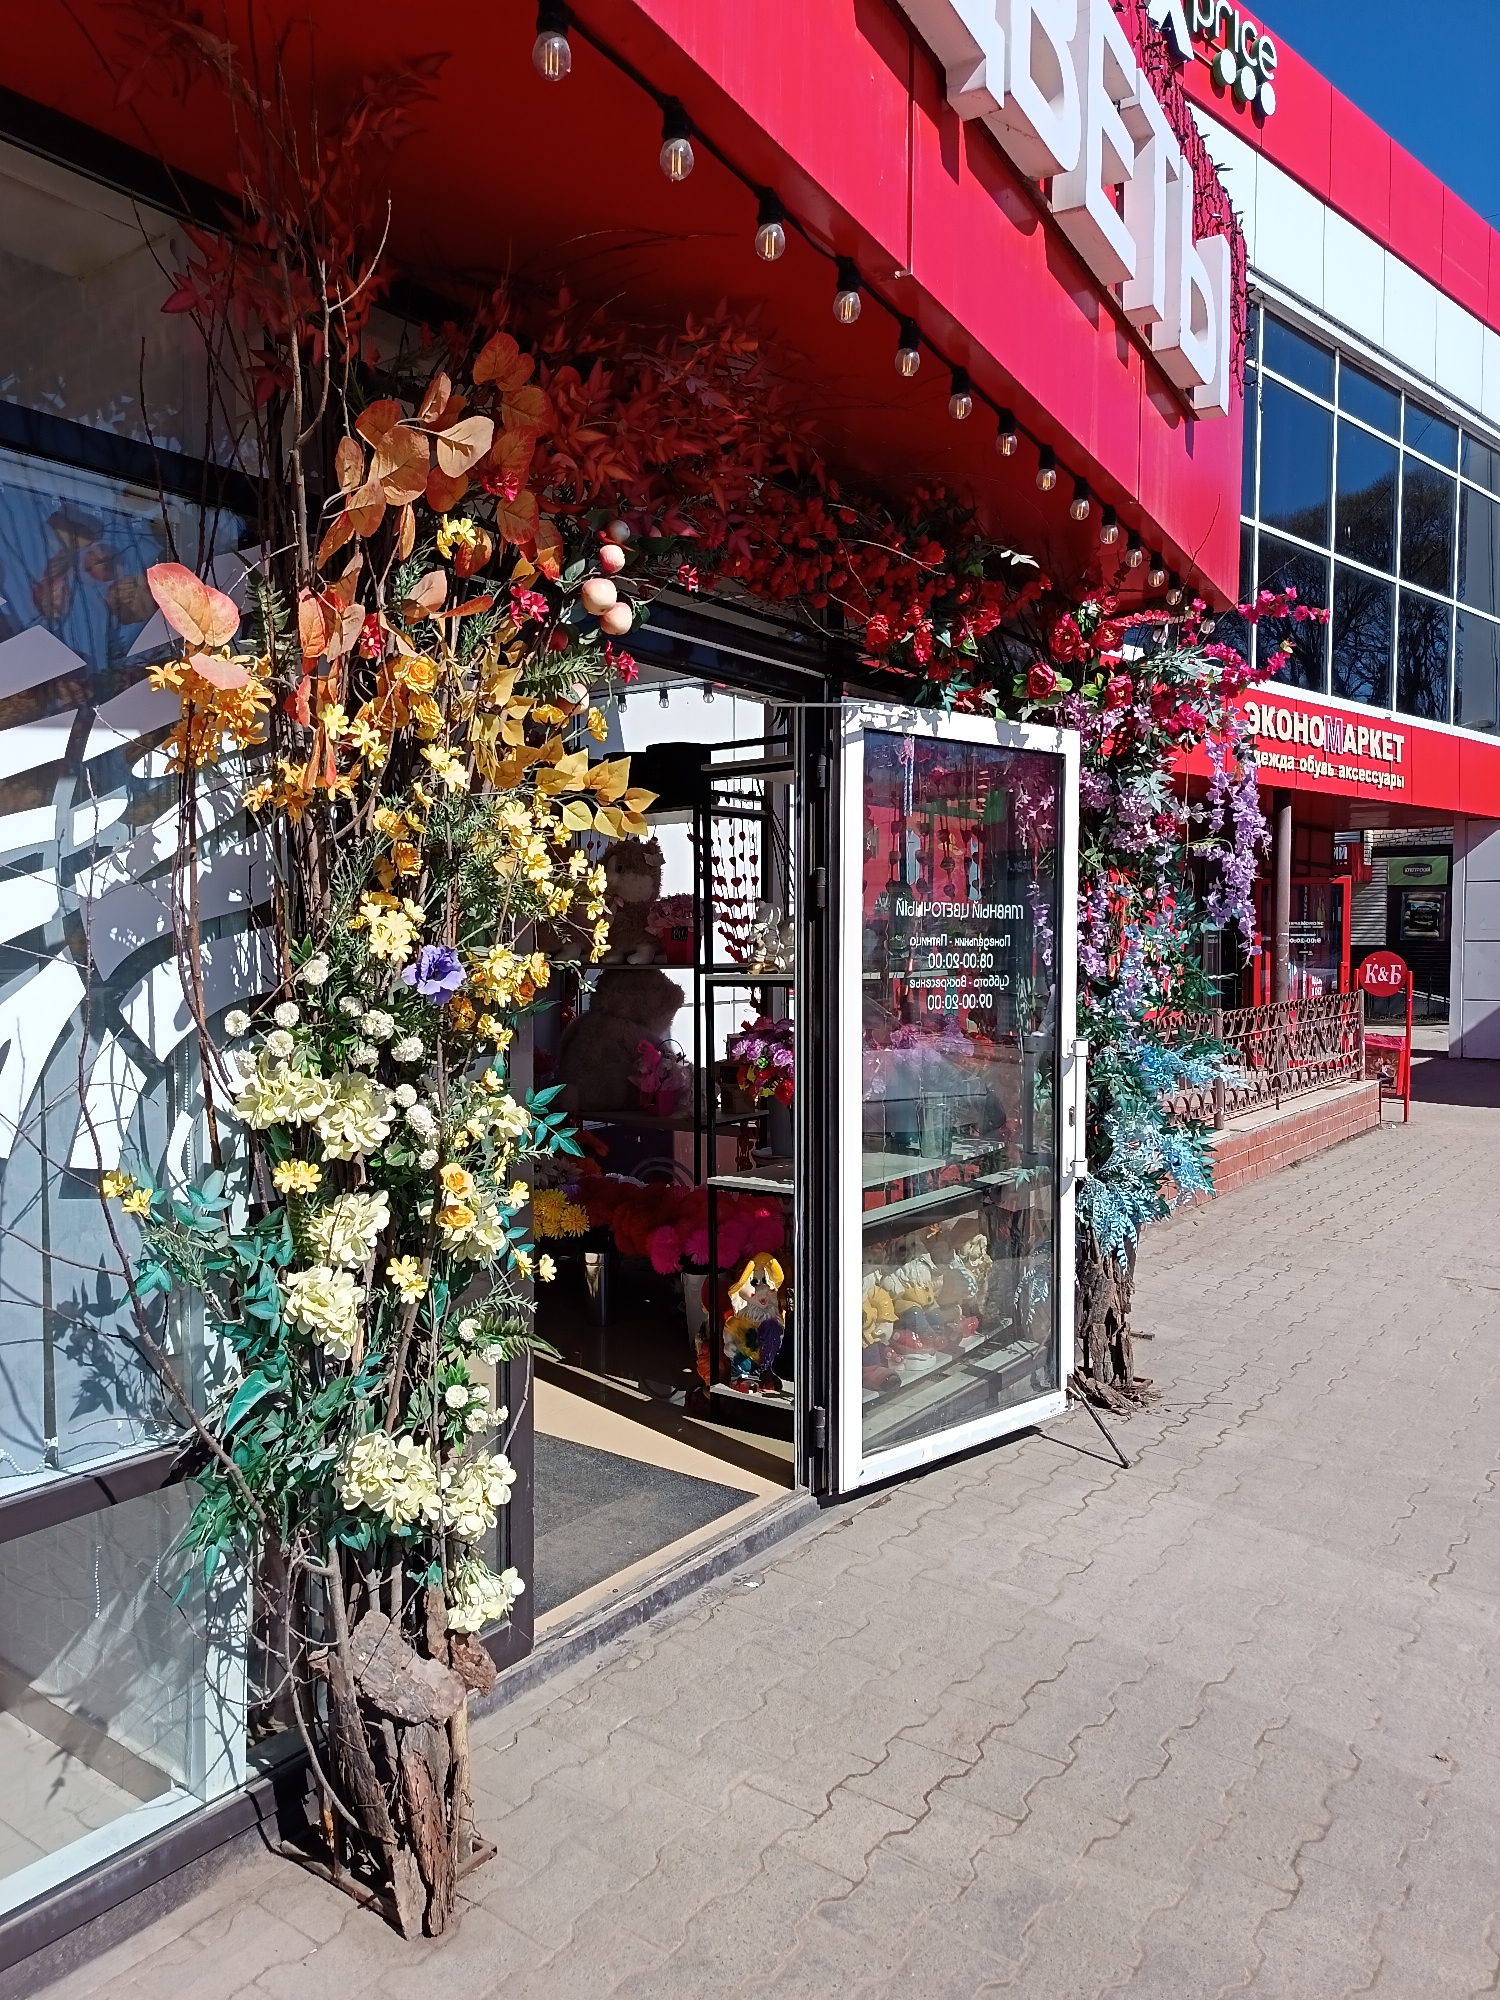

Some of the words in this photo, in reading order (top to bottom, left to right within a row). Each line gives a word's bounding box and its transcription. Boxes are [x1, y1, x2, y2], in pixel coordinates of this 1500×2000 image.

[1190, 0, 1278, 80] price
[1244, 701, 1405, 763] ЭКОНОМАРКЕТ
[1253, 750, 1295, 772] дежда
[1299, 754, 1334, 778] обувь
[1339, 764, 1405, 789] аксессуары
[1364, 963, 1402, 985] К&Б
